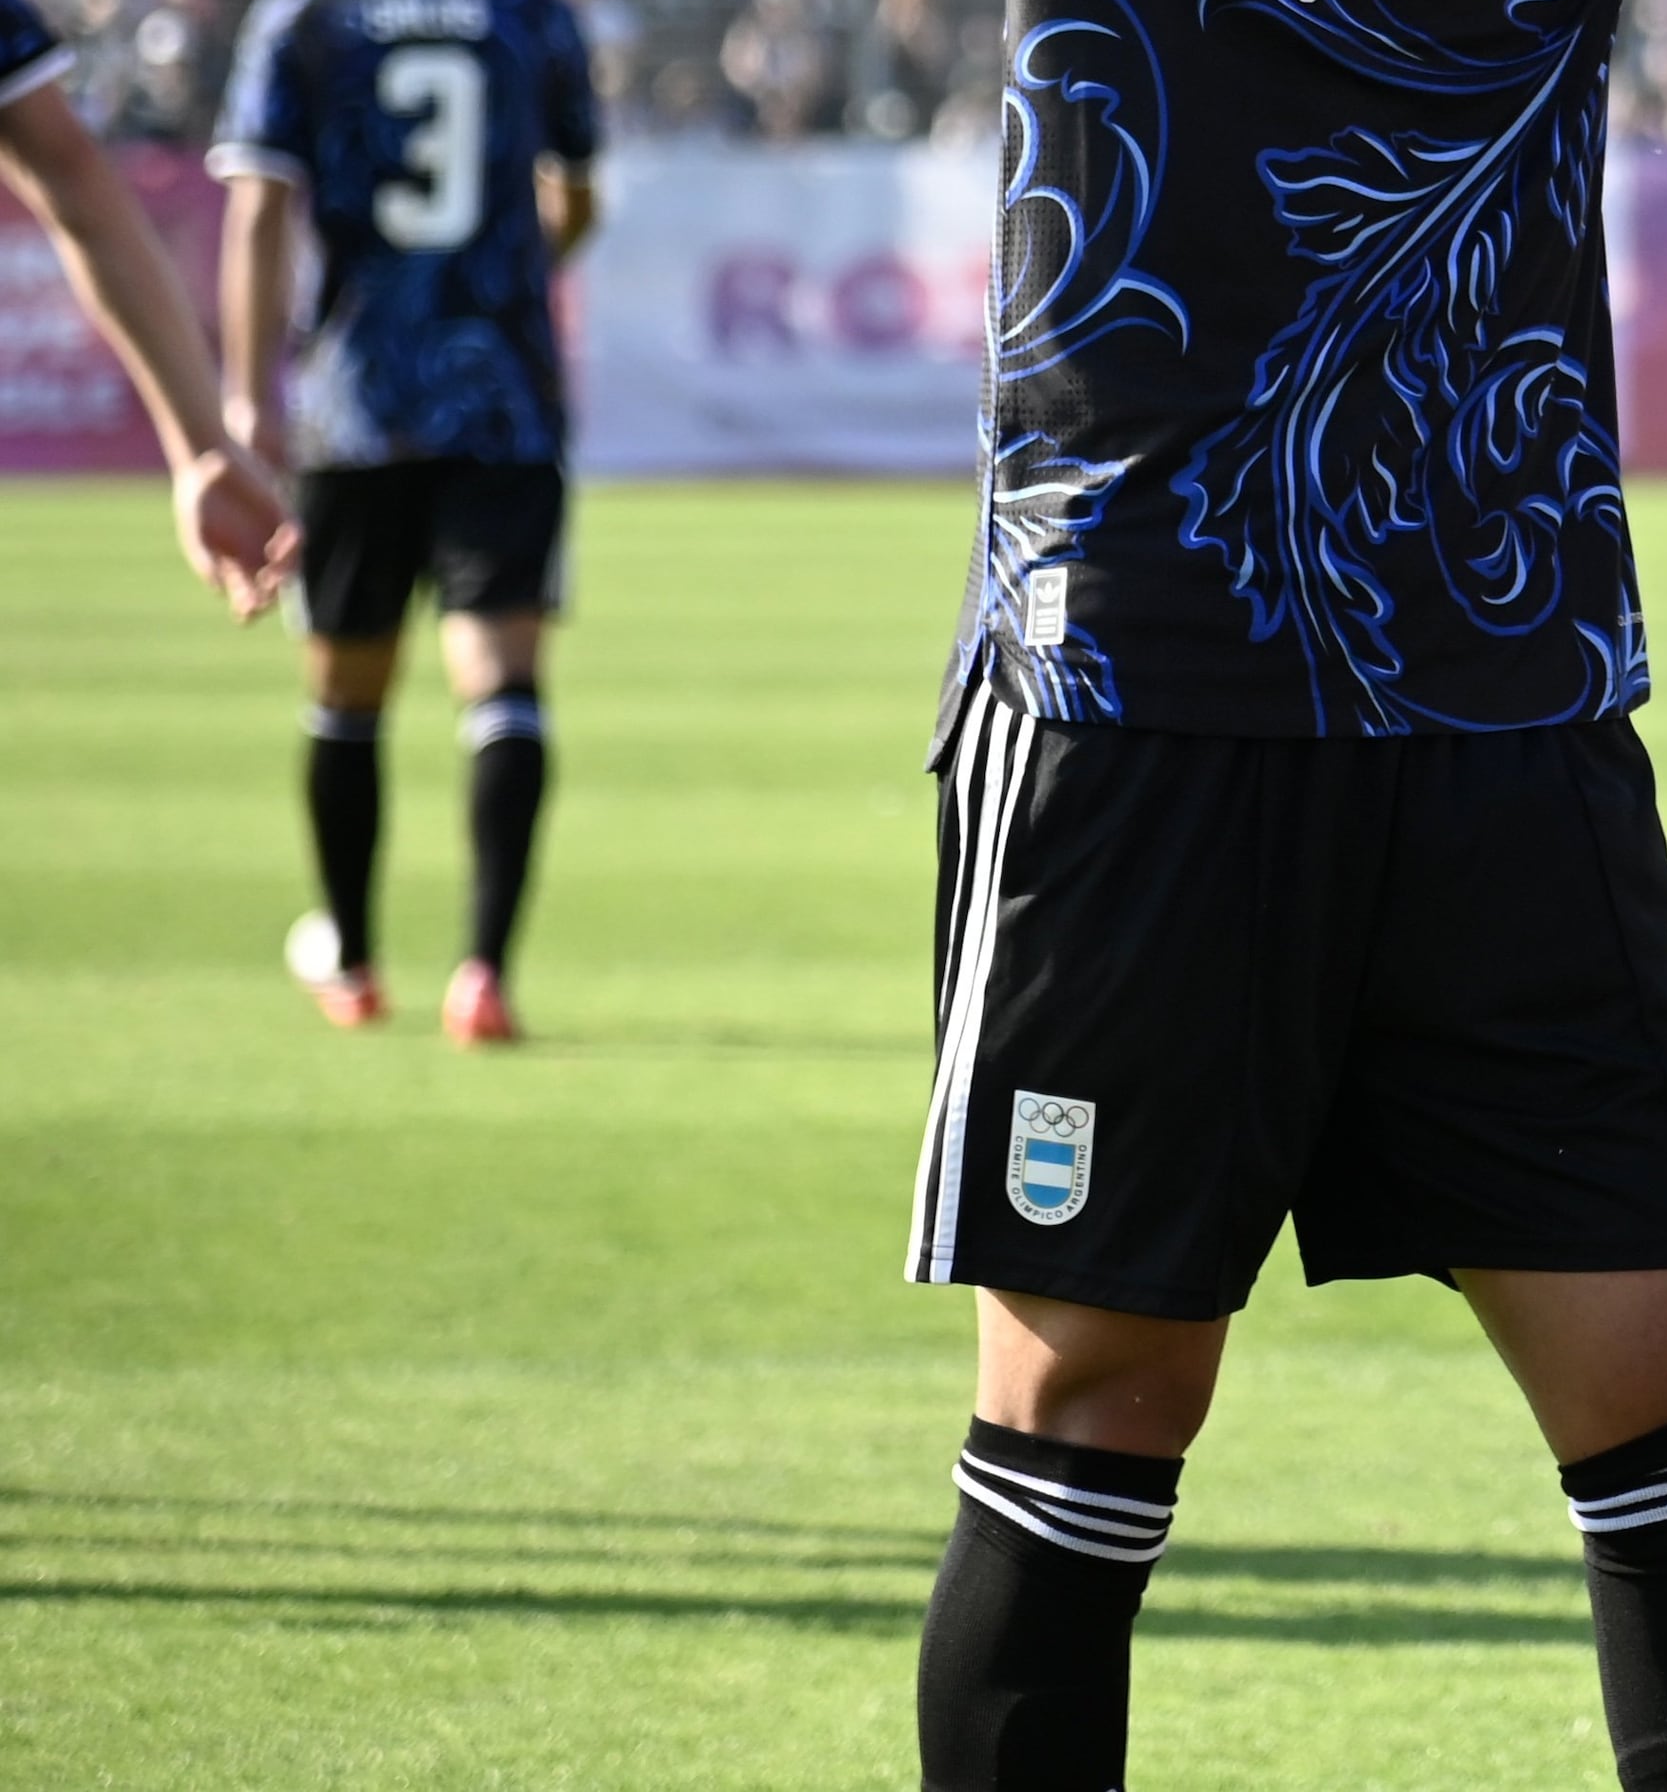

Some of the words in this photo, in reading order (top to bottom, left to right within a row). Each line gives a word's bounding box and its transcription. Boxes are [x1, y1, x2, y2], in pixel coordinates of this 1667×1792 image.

[374, 45, 486, 254] 3
[1011, 1136, 1024, 1179] COMITE
[1066, 1144, 1087, 1212] ARGENTINO
[1011, 1187, 1063, 1220] OLIMPICO
